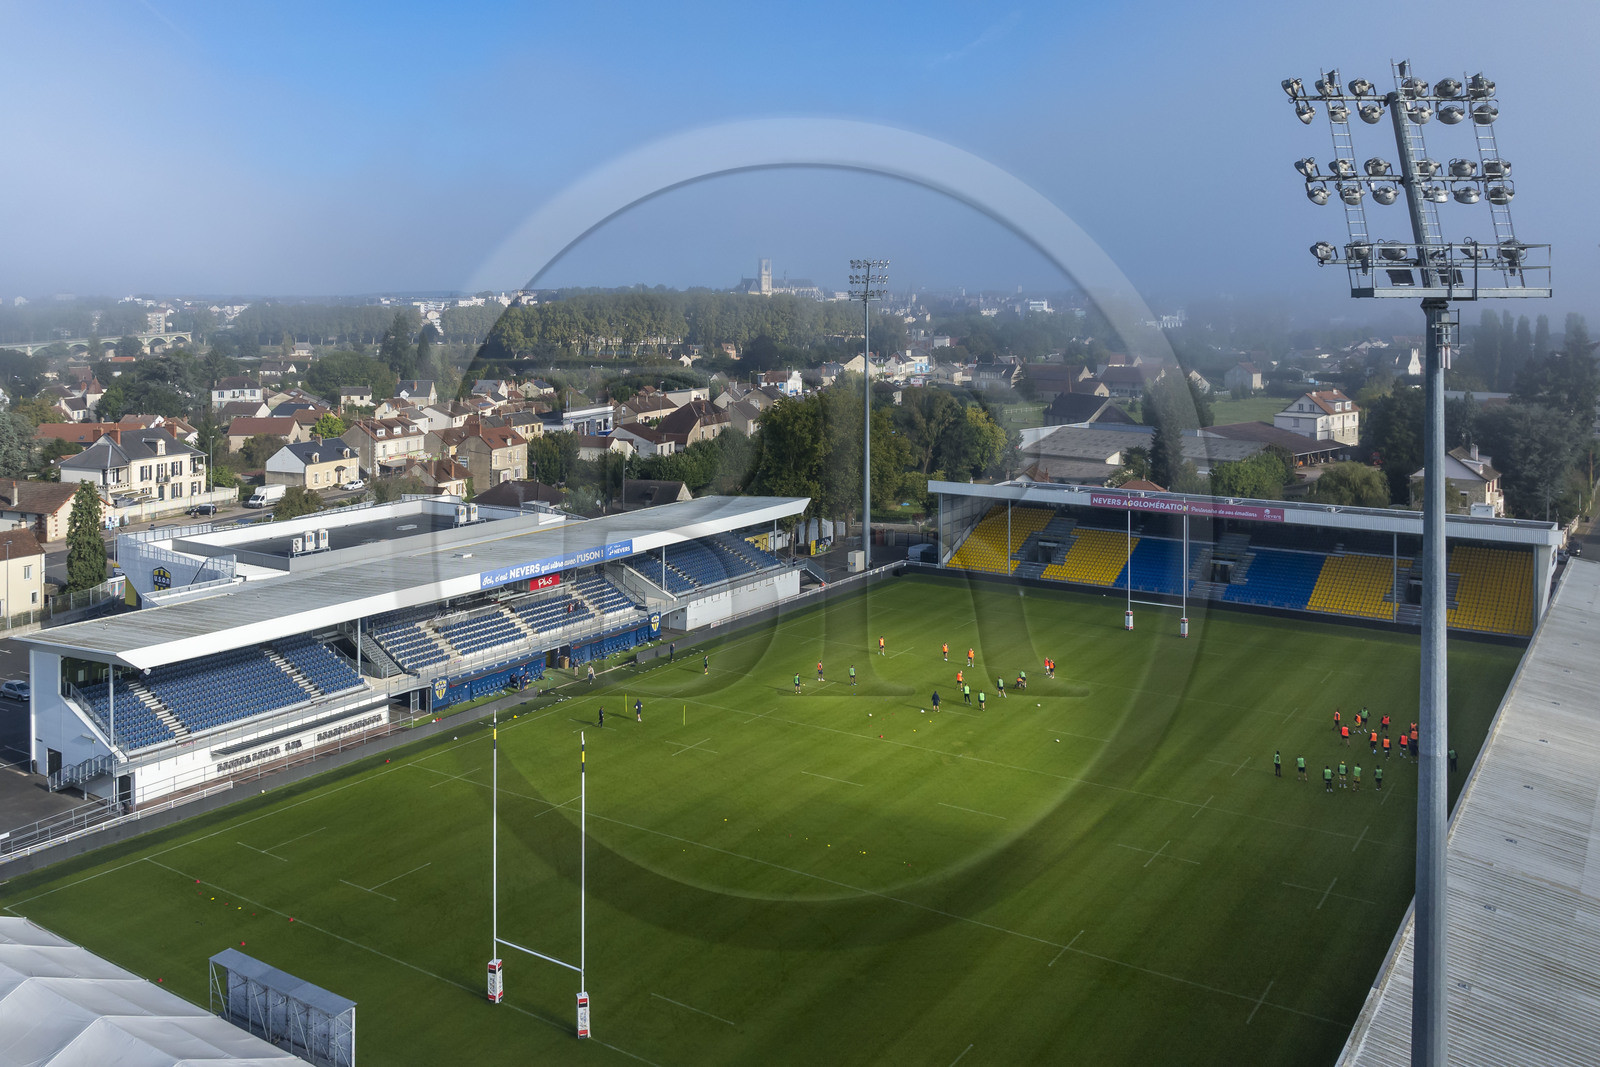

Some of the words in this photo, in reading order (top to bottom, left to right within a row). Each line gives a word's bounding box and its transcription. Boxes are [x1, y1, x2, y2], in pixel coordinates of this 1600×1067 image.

[1092, 497, 1122, 506] NEVERS
[1122, 499, 1189, 512] AGGLOMÉRATION
[614, 546, 631, 555] NEVERS
[509, 563, 540, 579] NEVERS
